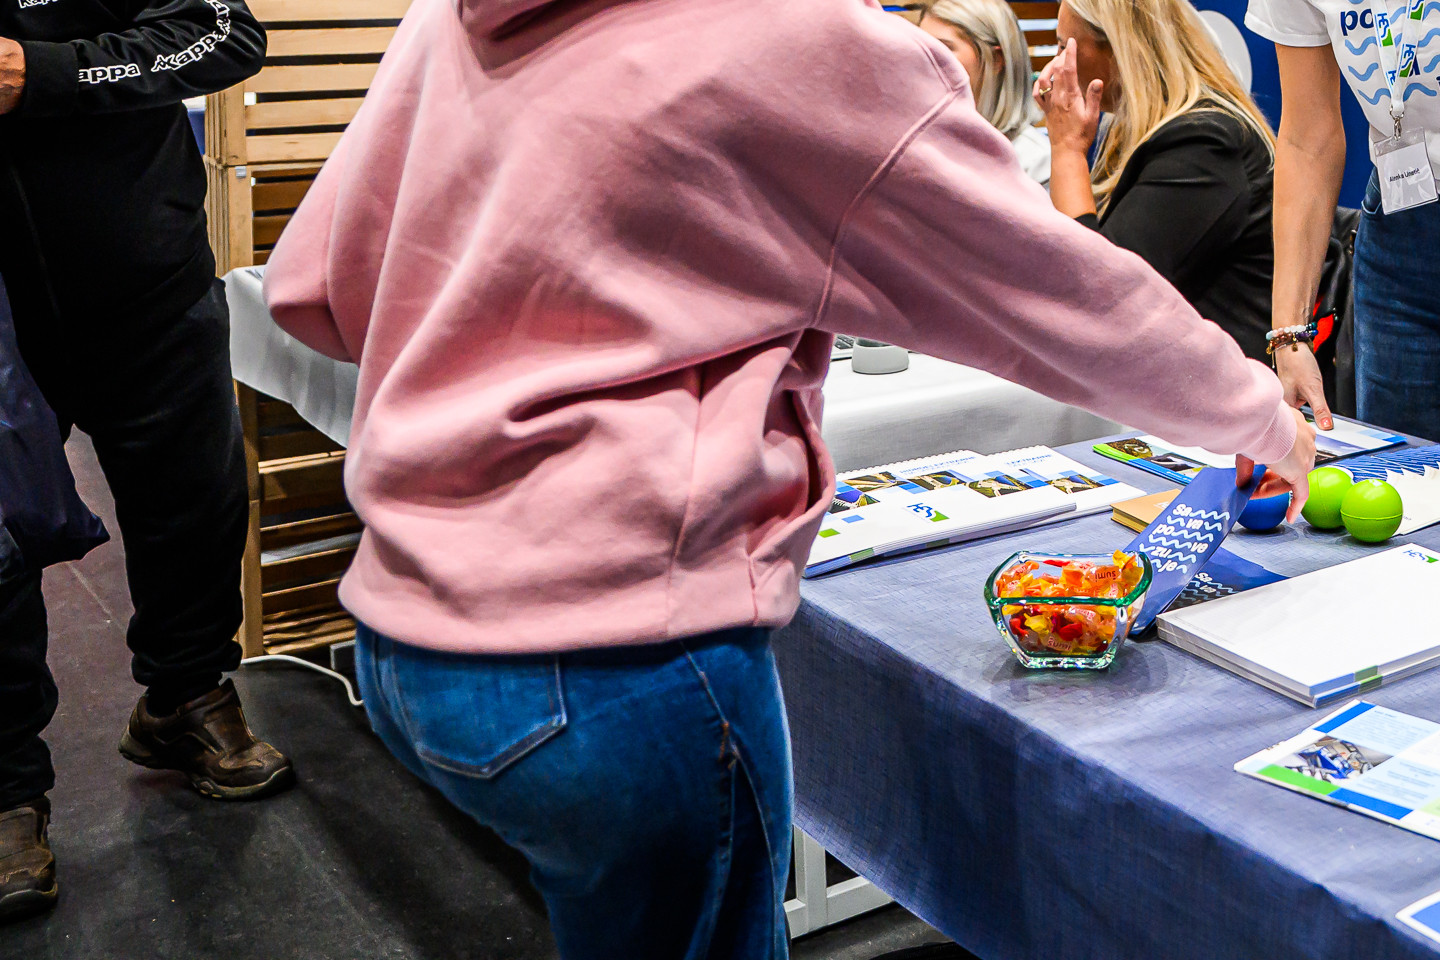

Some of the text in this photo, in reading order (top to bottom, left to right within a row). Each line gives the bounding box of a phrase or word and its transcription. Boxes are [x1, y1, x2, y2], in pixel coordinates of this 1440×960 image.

[78, 63, 142, 84] appa
[1152, 523, 1174, 536] po
[1186, 518, 1204, 530] va
[1151, 546, 1172, 559] zu
[1190, 542, 1209, 554] ve
[1158, 560, 1178, 573] je
